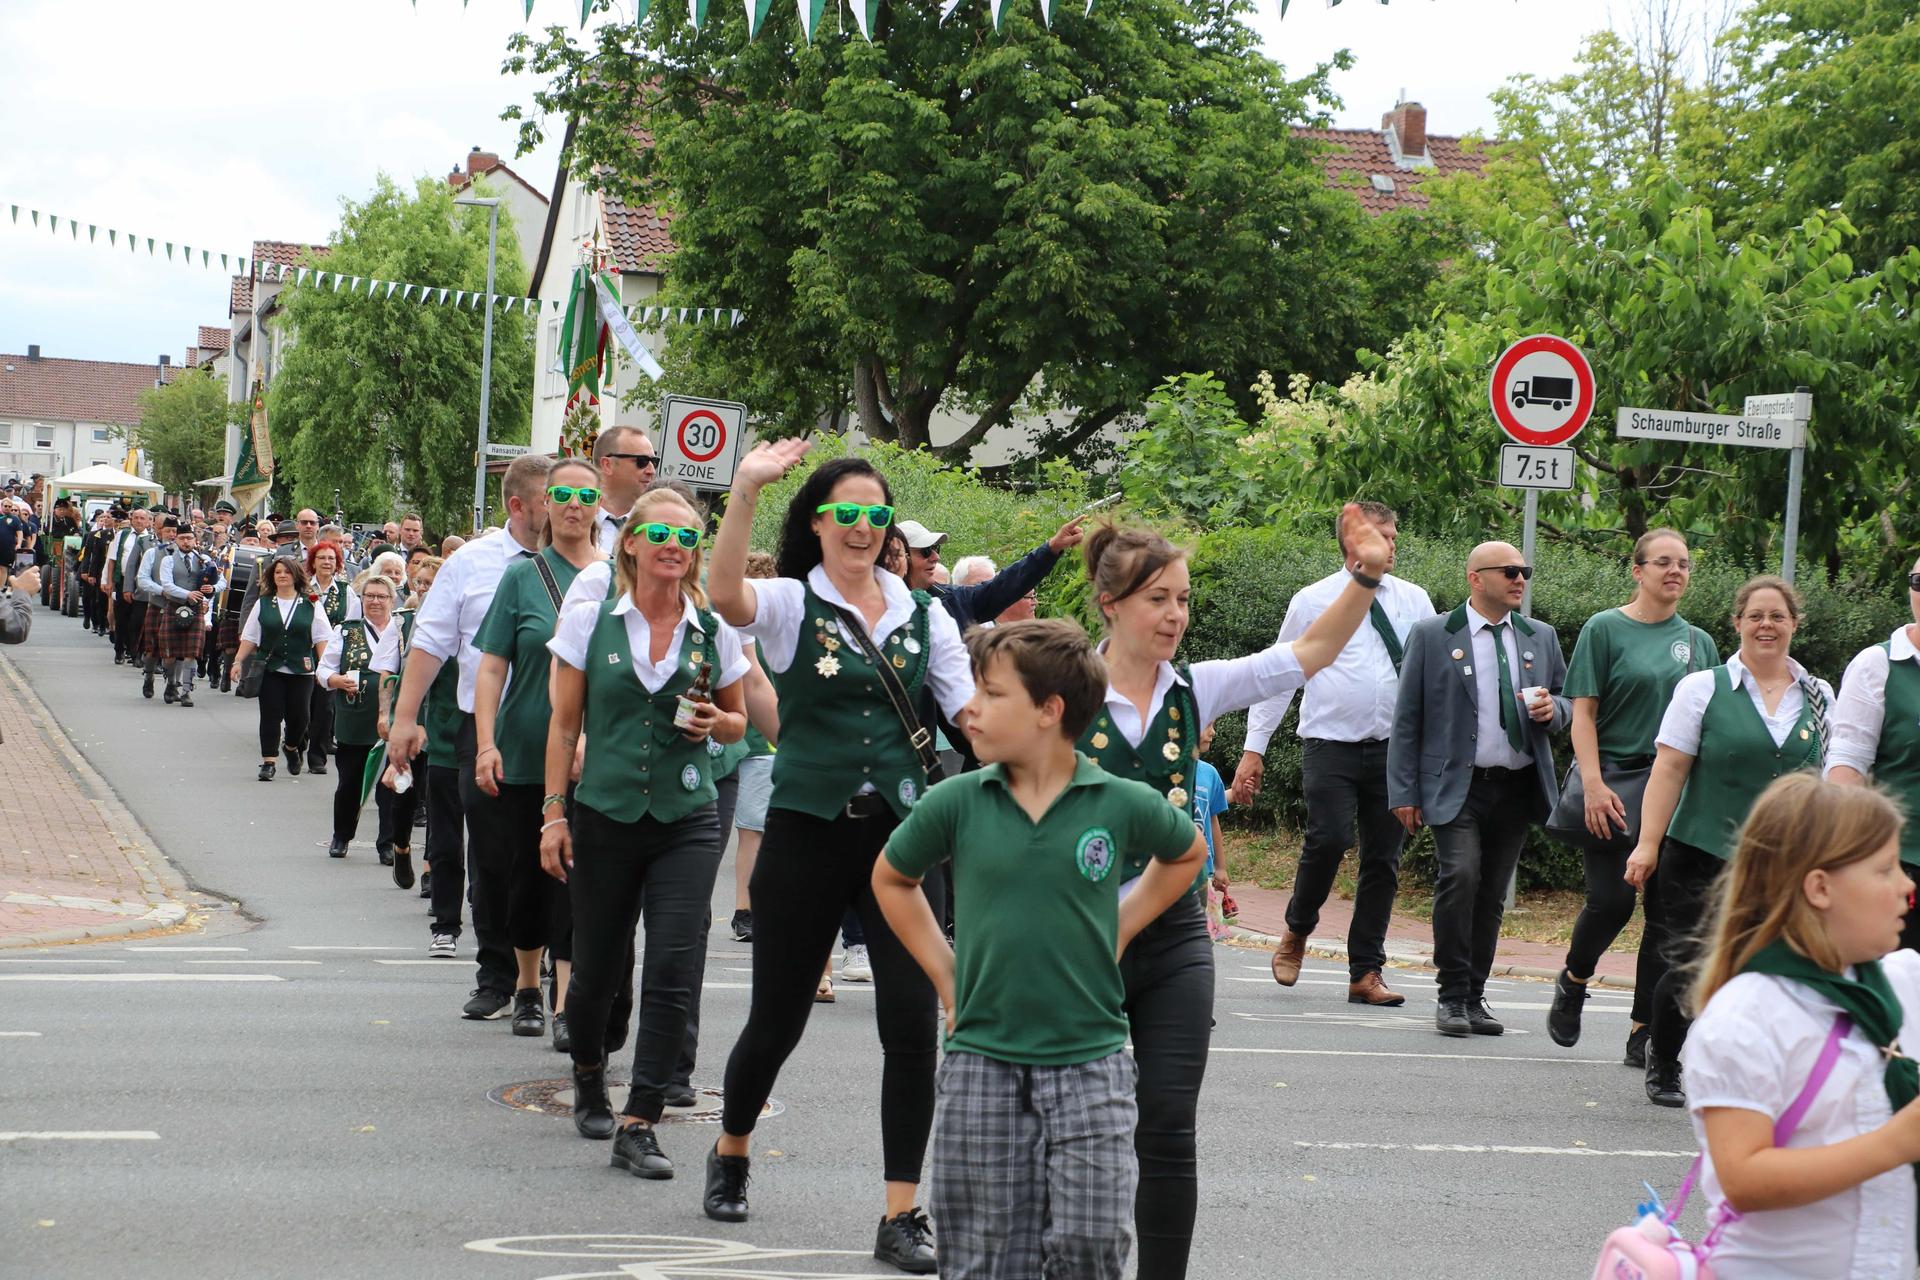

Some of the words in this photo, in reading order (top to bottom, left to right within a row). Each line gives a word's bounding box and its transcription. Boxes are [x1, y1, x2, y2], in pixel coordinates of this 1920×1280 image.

[687, 423, 716, 448] 30
[1631, 412, 1730, 440] Schaumburger
[1737, 420, 1782, 441] Straße
[491, 445, 528, 455] Hansastraße
[678, 463, 715, 480] ZONE
